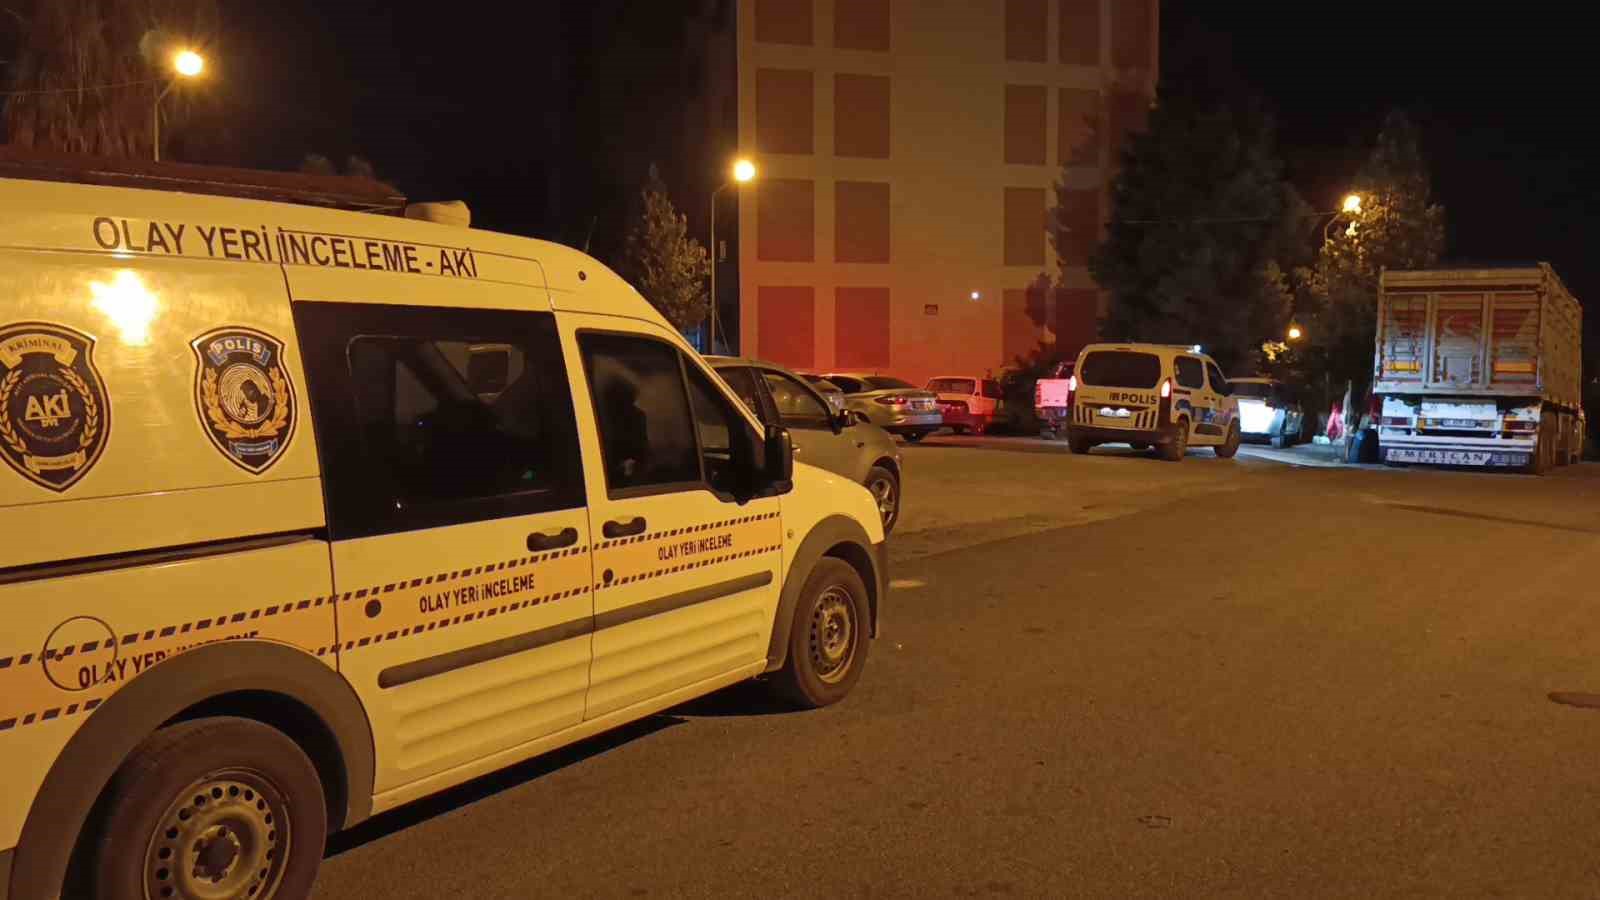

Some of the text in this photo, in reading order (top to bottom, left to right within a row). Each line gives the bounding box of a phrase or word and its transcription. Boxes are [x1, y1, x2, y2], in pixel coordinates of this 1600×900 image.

[93, 217, 185, 255] OLAY
[197, 224, 272, 262] YERİ
[439, 246, 478, 278] AKİ
[657, 545, 678, 561] OLAY
[420, 573, 535, 613] OLAY YERİ İNCELEME
[79, 649, 170, 688] OLAY YER
